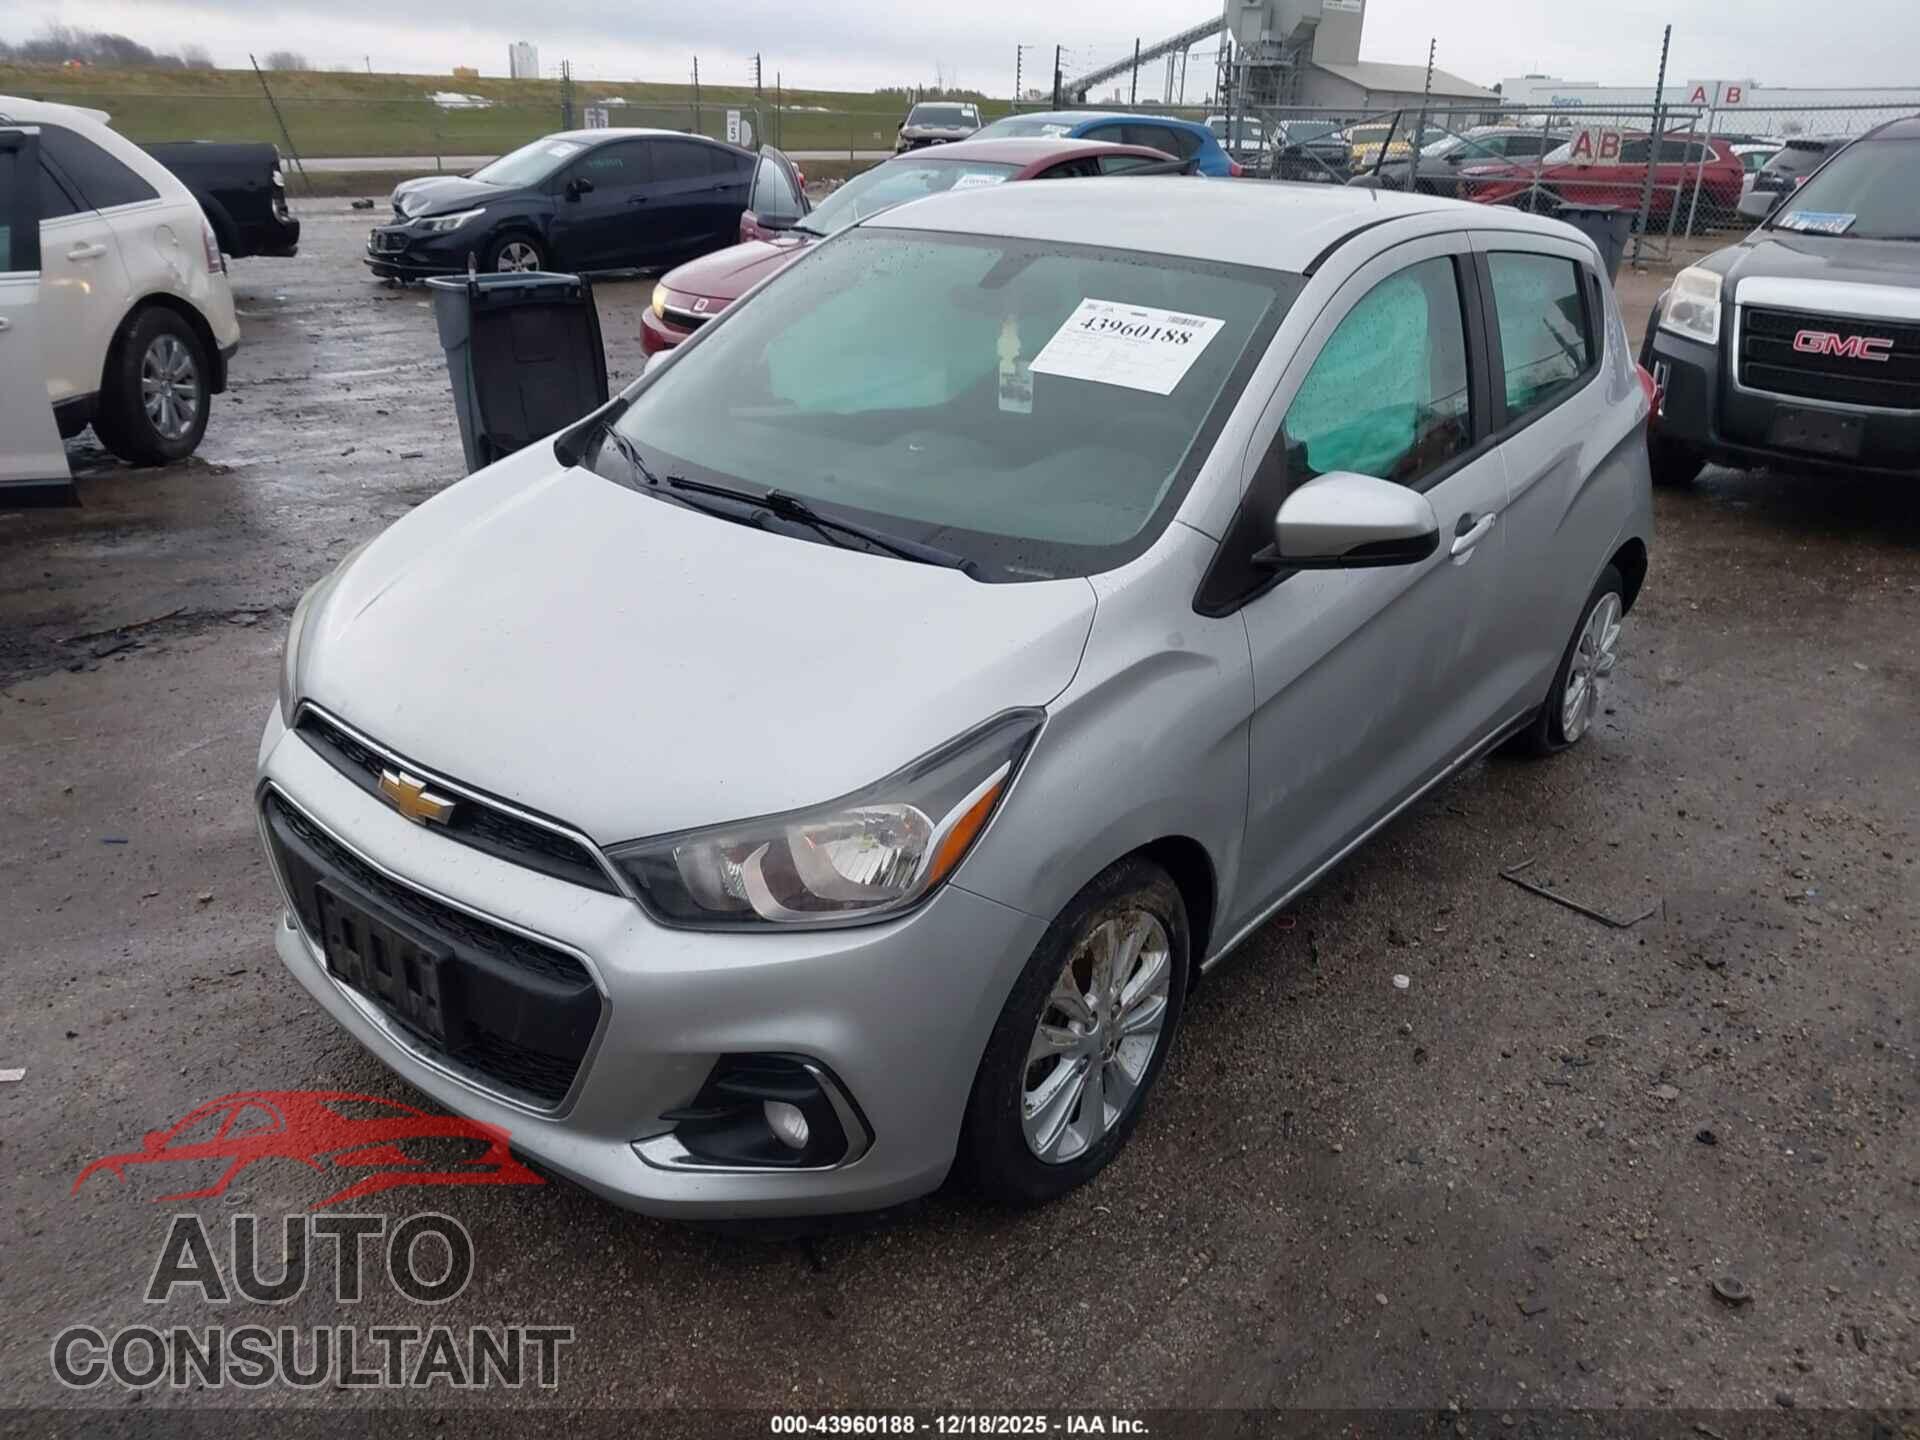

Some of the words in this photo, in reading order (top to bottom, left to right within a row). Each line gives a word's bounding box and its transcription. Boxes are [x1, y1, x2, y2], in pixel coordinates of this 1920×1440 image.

[1690, 86, 1706, 103] A
[1726, 86, 1741, 103] B
[1080, 317, 1193, 345] 43960188
[1793, 329, 1894, 361] GMC
